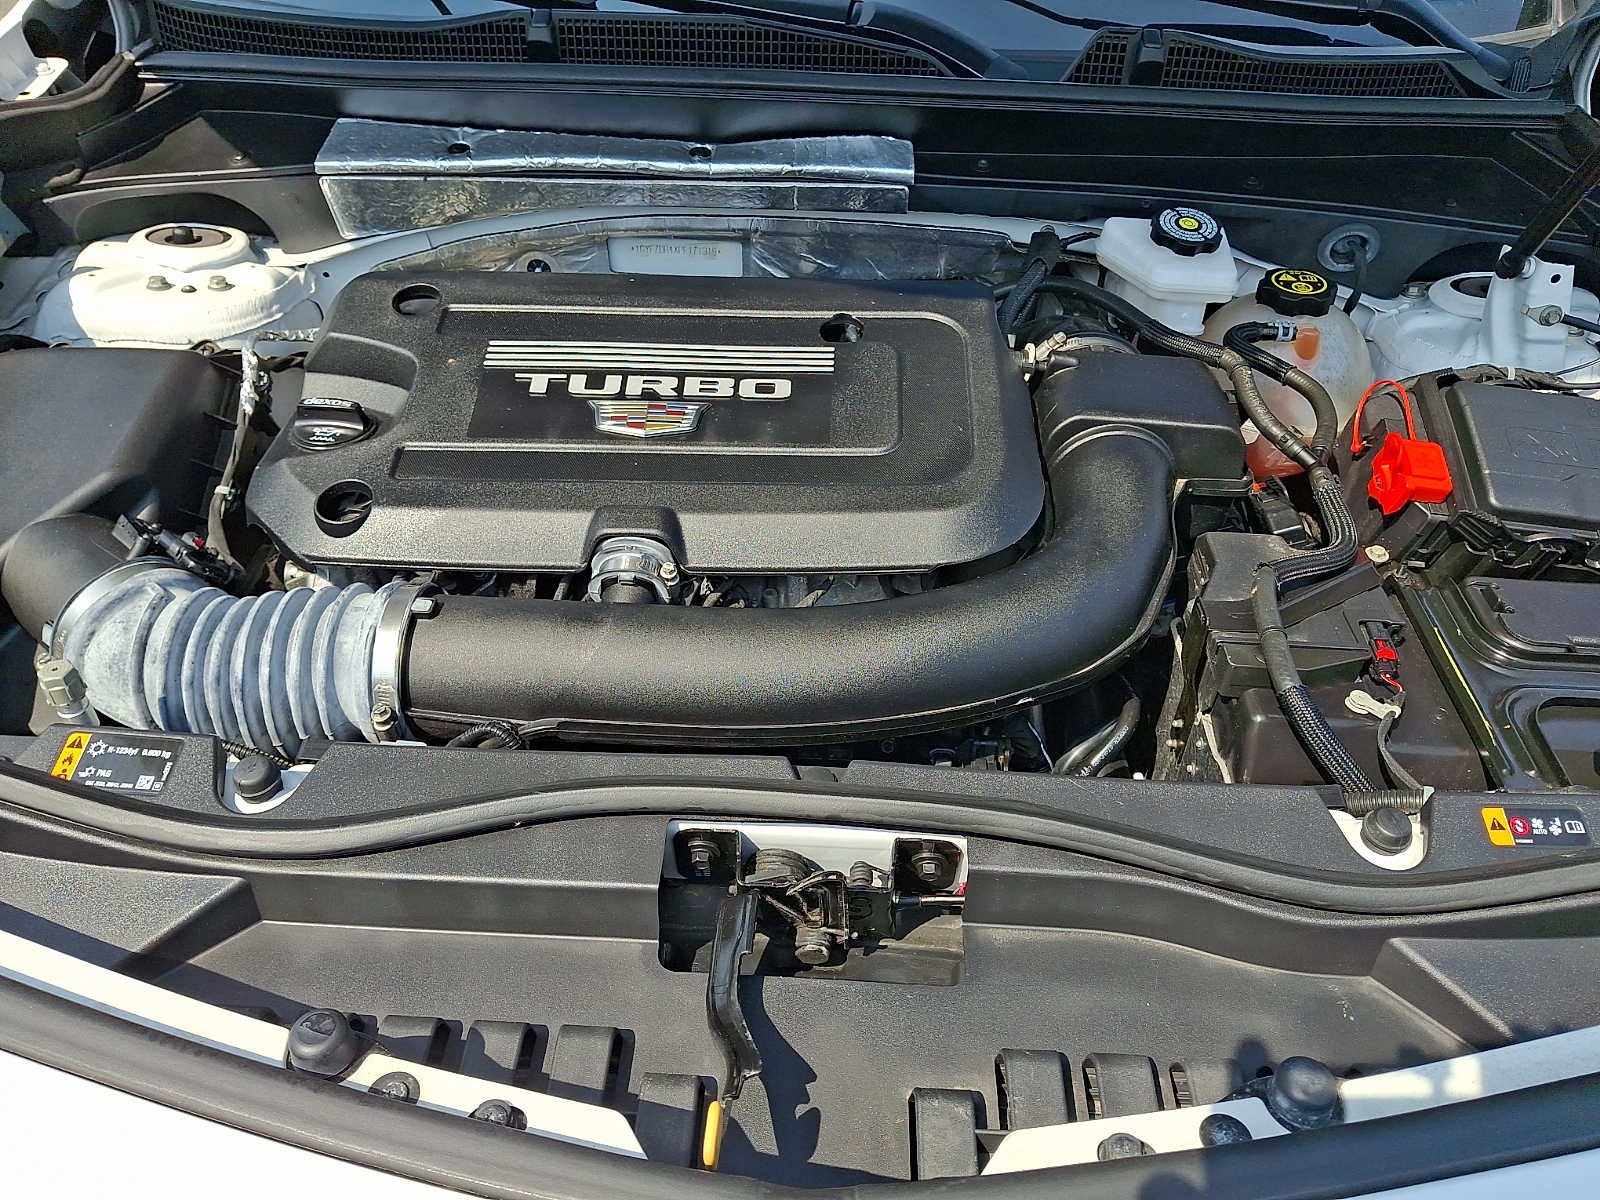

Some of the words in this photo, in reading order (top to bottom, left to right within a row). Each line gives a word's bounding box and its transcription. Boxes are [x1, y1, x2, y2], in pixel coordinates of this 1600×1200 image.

[514, 373, 792, 399] TURBO
[303, 397, 354, 408] dexos
[95, 769, 112, 778] PAG
